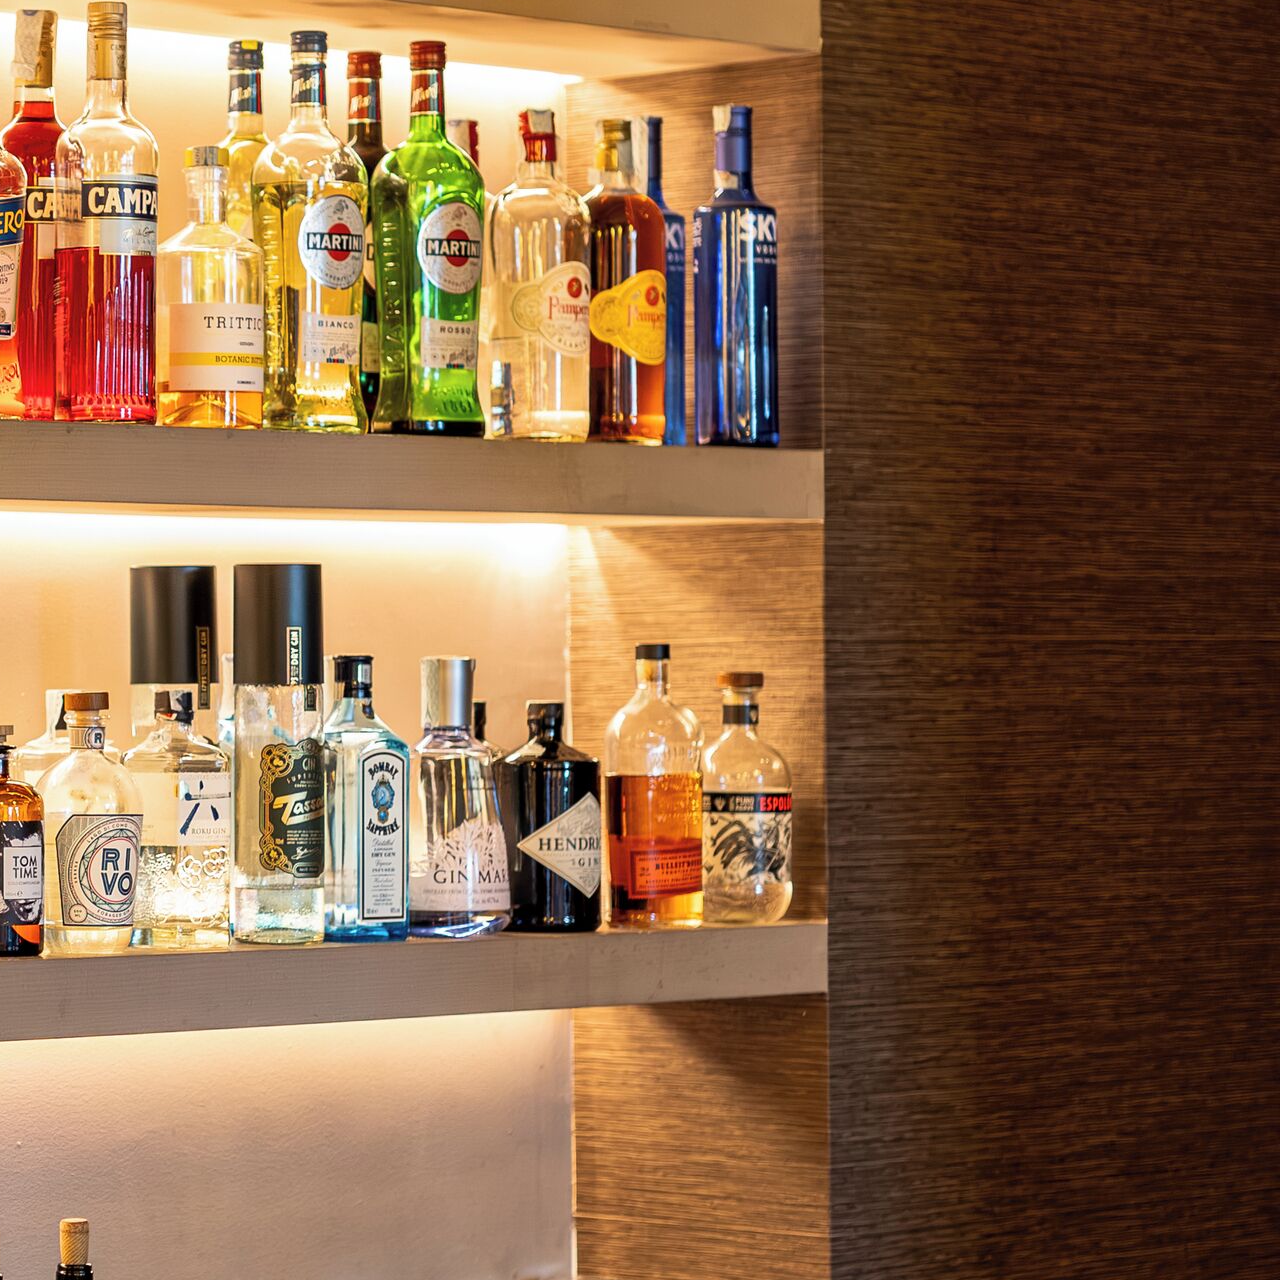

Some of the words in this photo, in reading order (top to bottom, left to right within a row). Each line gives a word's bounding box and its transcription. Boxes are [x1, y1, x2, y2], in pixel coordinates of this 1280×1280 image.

[308, 234, 362, 252] MARTINI
[427, 240, 481, 258] MARTINI
[318, 320, 354, 329] BIANCO
[439, 326, 471, 335] ROSSO
[215, 355, 250, 364] BOTANIC
[290, 630, 299, 646] GIN
[290, 647, 299, 666] DRY
[94, 732, 103, 744] R
[367, 761, 399, 781] BOMBAY
[191, 827, 212, 835] ROKU
[213, 827, 226, 835] GIN
[366, 818, 401, 836] SAPPHIRE
[12, 855, 38, 868] TOM
[12, 867, 38, 879] TIME
[433, 870, 468, 884] GIN
